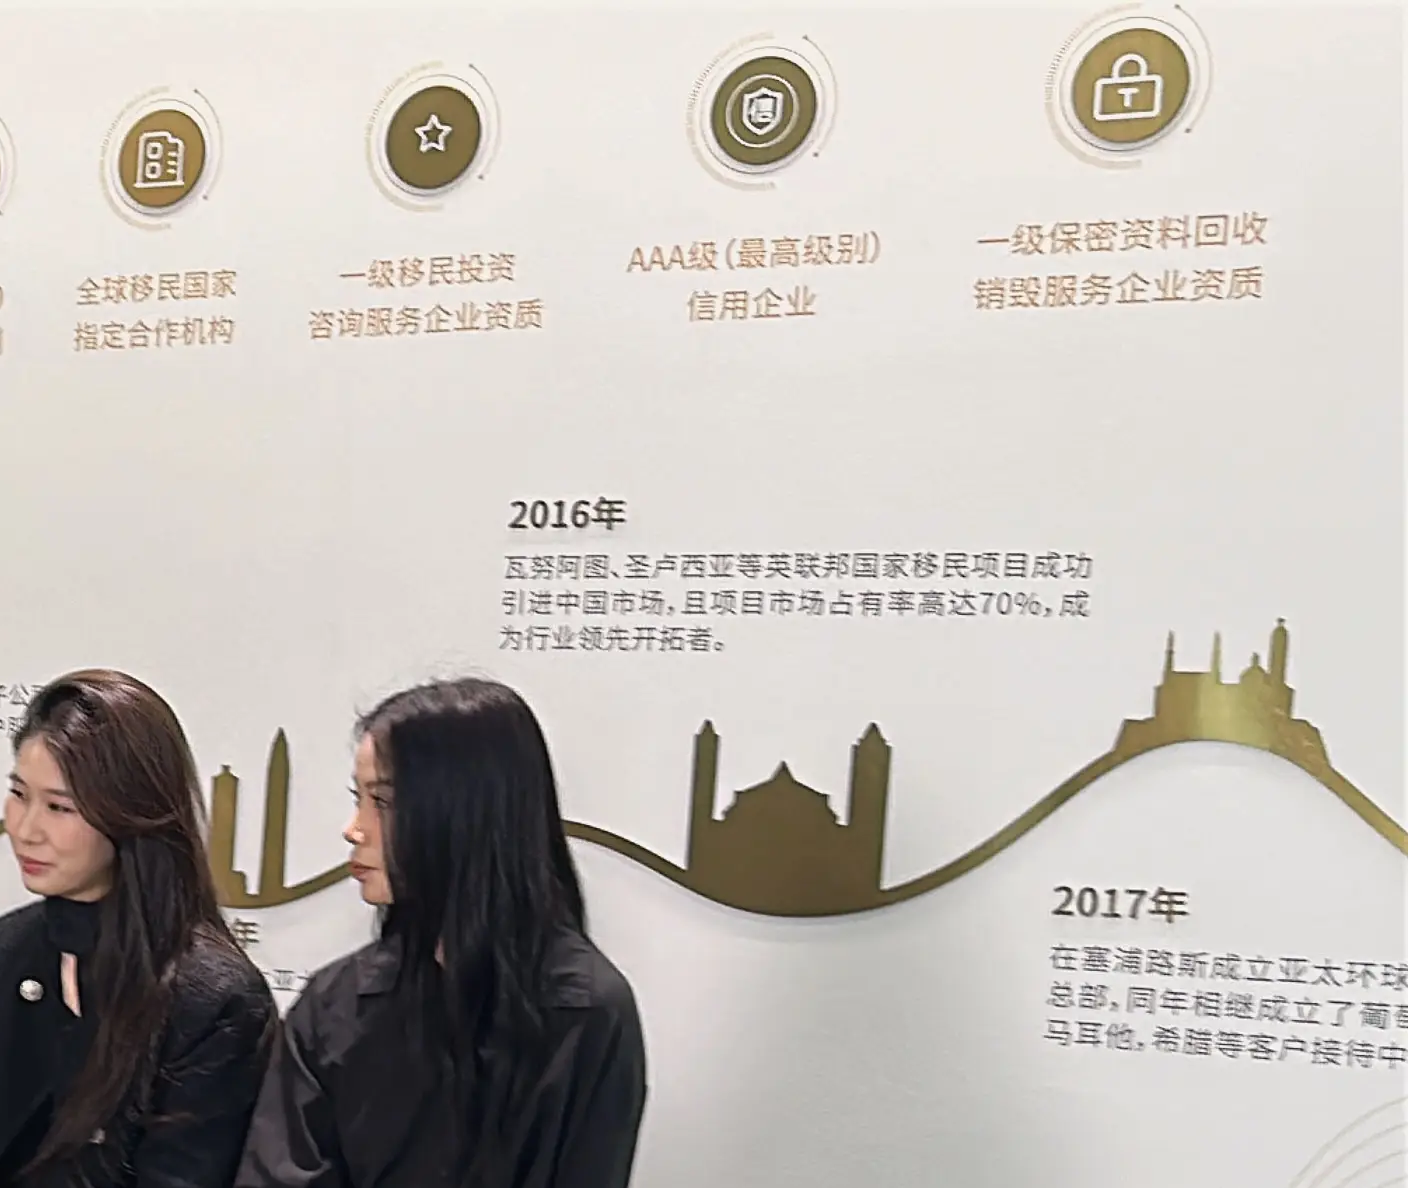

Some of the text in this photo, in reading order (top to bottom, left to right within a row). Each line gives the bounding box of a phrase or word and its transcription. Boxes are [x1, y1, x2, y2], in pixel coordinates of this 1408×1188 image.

[977, 212, 1268, 257] 一级保密资料回收
[76, 269, 237, 306] 全球移民国家
[339, 253, 517, 289] 一级移民投资
[973, 266, 1264, 311] 销毁服务企业资质
[309, 298, 543, 341] 咨询服务企业资质
[687, 285, 817, 321] 信用企业
[74, 316, 235, 352] 指定合作机构
[507, 497, 627, 530] 2016年
[499, 624, 725, 652] 为行业领先开拓者。
[1051, 885, 1190, 924] 2017年
